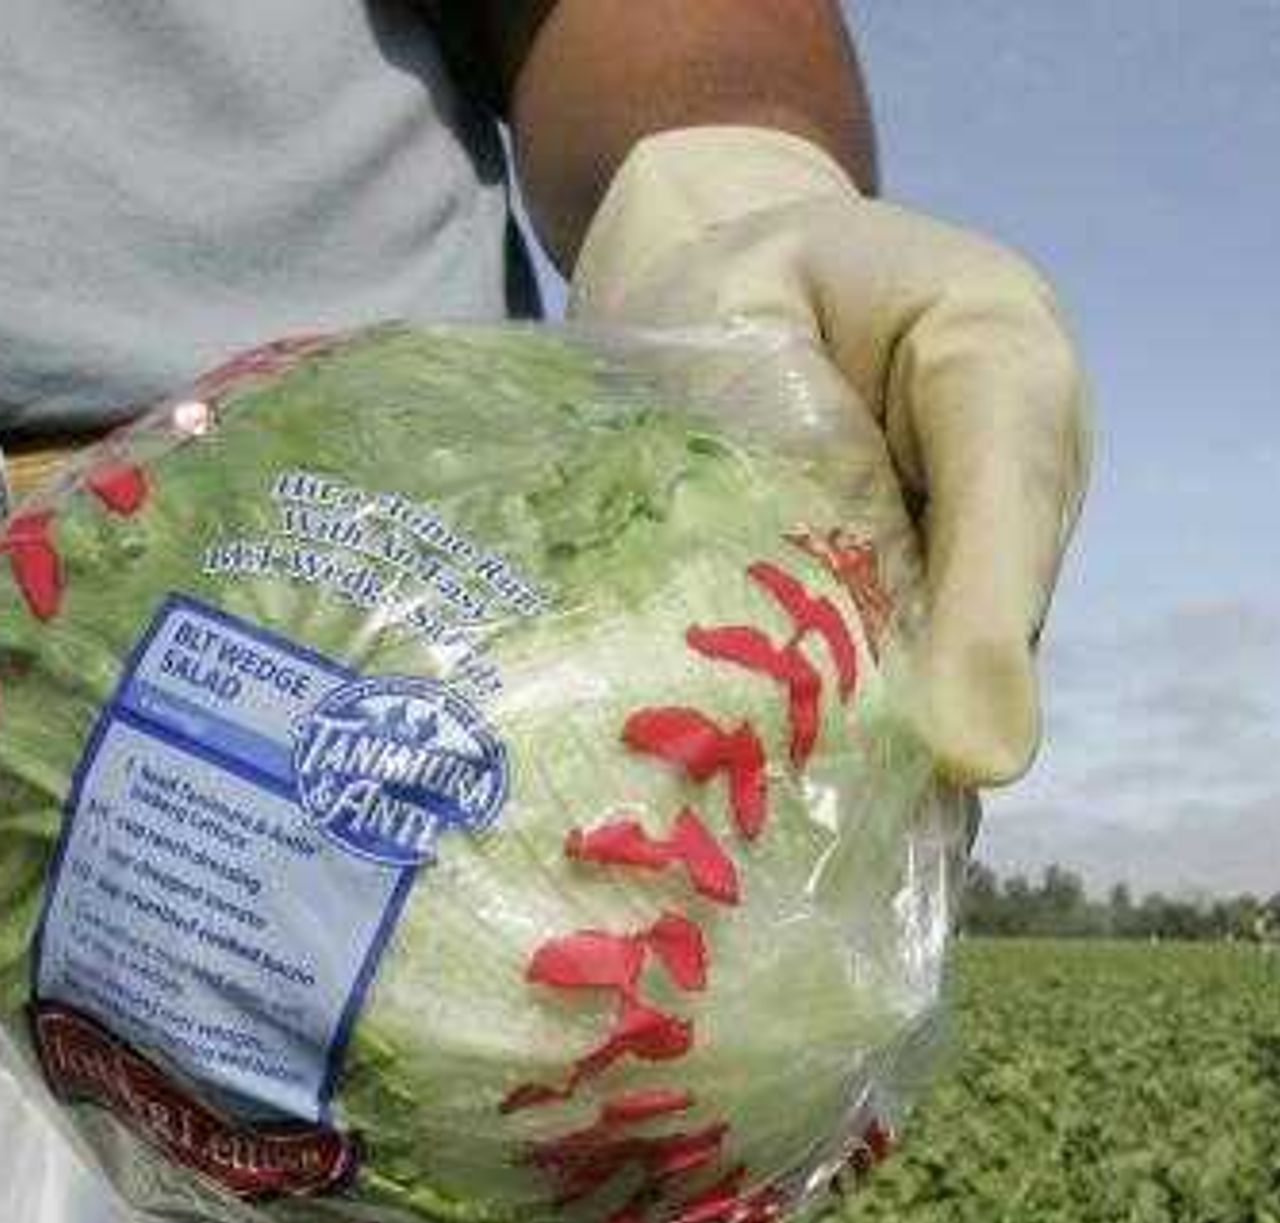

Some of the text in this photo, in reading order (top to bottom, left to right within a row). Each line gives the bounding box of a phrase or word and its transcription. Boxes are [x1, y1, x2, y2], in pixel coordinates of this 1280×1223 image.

[161, 648, 243, 699] SALAD
[175, 621, 311, 700] BLT WEDGE
